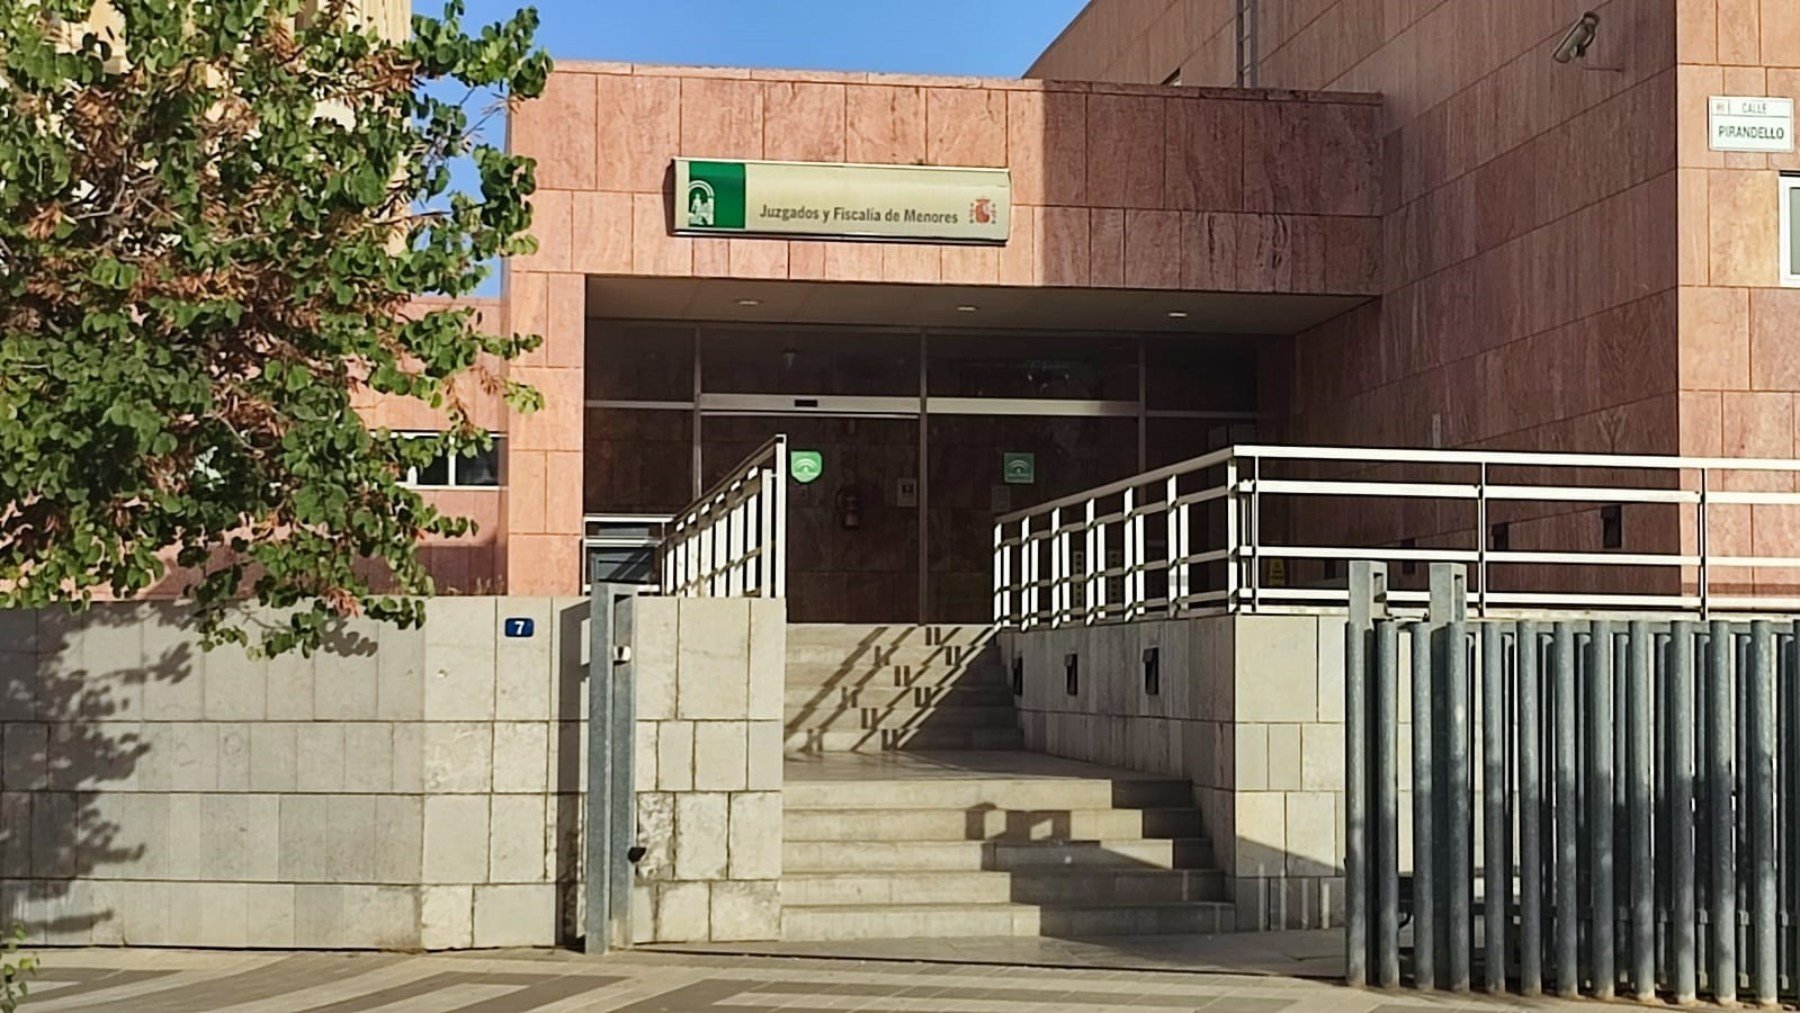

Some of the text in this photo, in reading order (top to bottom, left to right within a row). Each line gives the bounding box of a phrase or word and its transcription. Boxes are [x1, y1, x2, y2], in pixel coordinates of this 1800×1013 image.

[1741, 102, 1767, 114] CALLE
[1718, 125, 1784, 140] PIRANDELLO
[760, 204, 819, 221] Juzgados
[823, 210, 830, 223] y
[885, 209, 899, 222] de
[904, 209, 958, 224] Menores
[514, 620, 525, 635] 7
